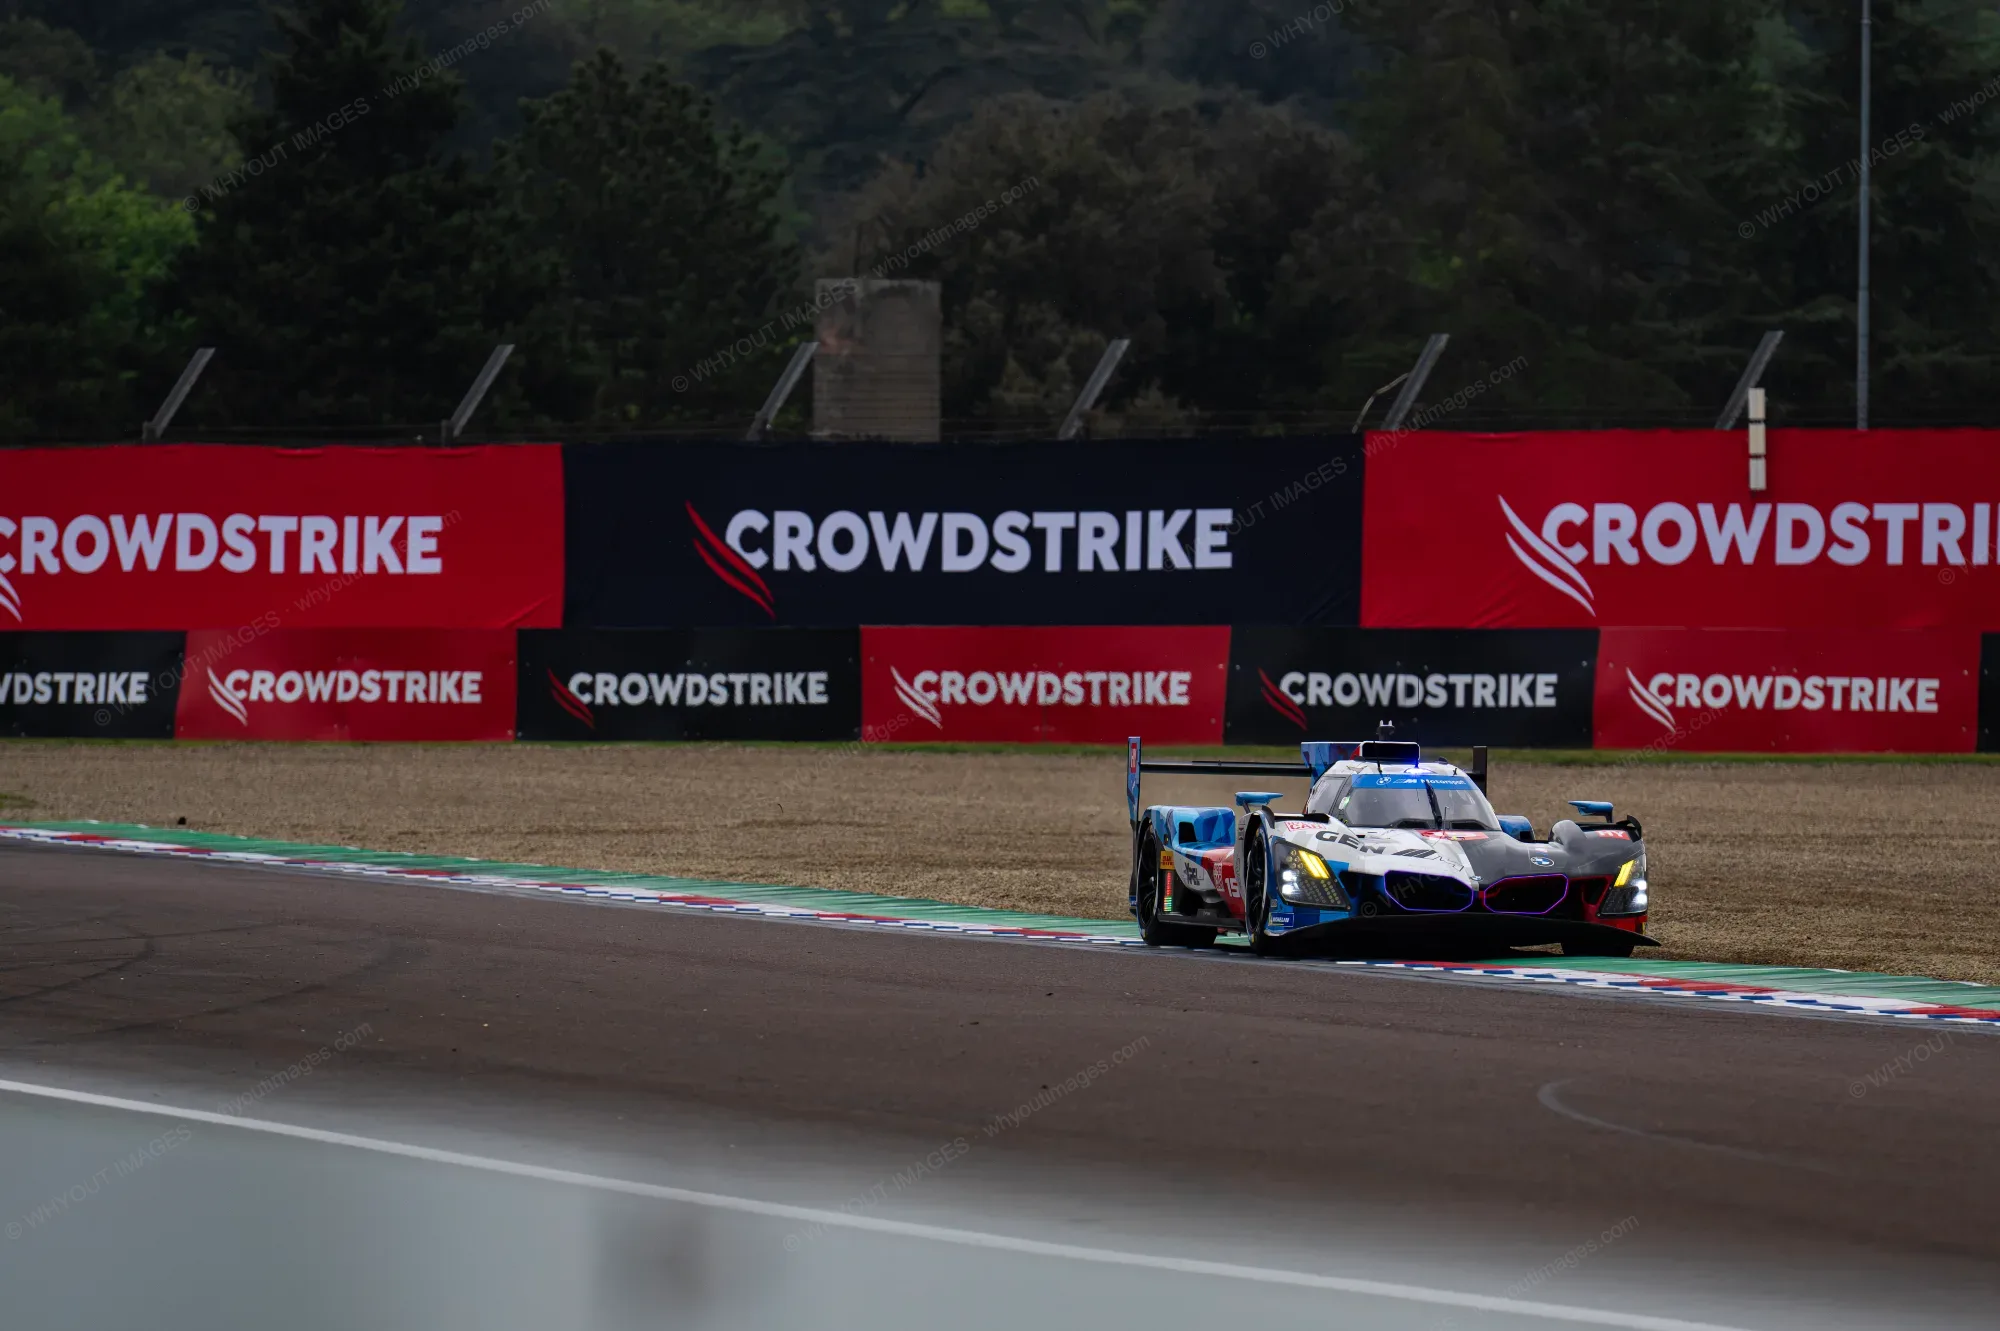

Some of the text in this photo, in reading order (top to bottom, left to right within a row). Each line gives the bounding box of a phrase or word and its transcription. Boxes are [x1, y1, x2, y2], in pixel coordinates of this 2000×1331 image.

[726, 508, 1233, 572] CROWDSTRIKE
[1541, 502, 2000, 566] CROWDSTRI
[225, 671, 482, 703] CROWDSTRIKE
[568, 672, 828, 706] CROWDSTRIKE
[913, 671, 1191, 706] CROWDSTRIKE
[1279, 672, 1558, 707] CROWDSTRIKE
[1649, 673, 1940, 712] CROWDSTRIKE
[1315, 830, 1386, 855] GEN
